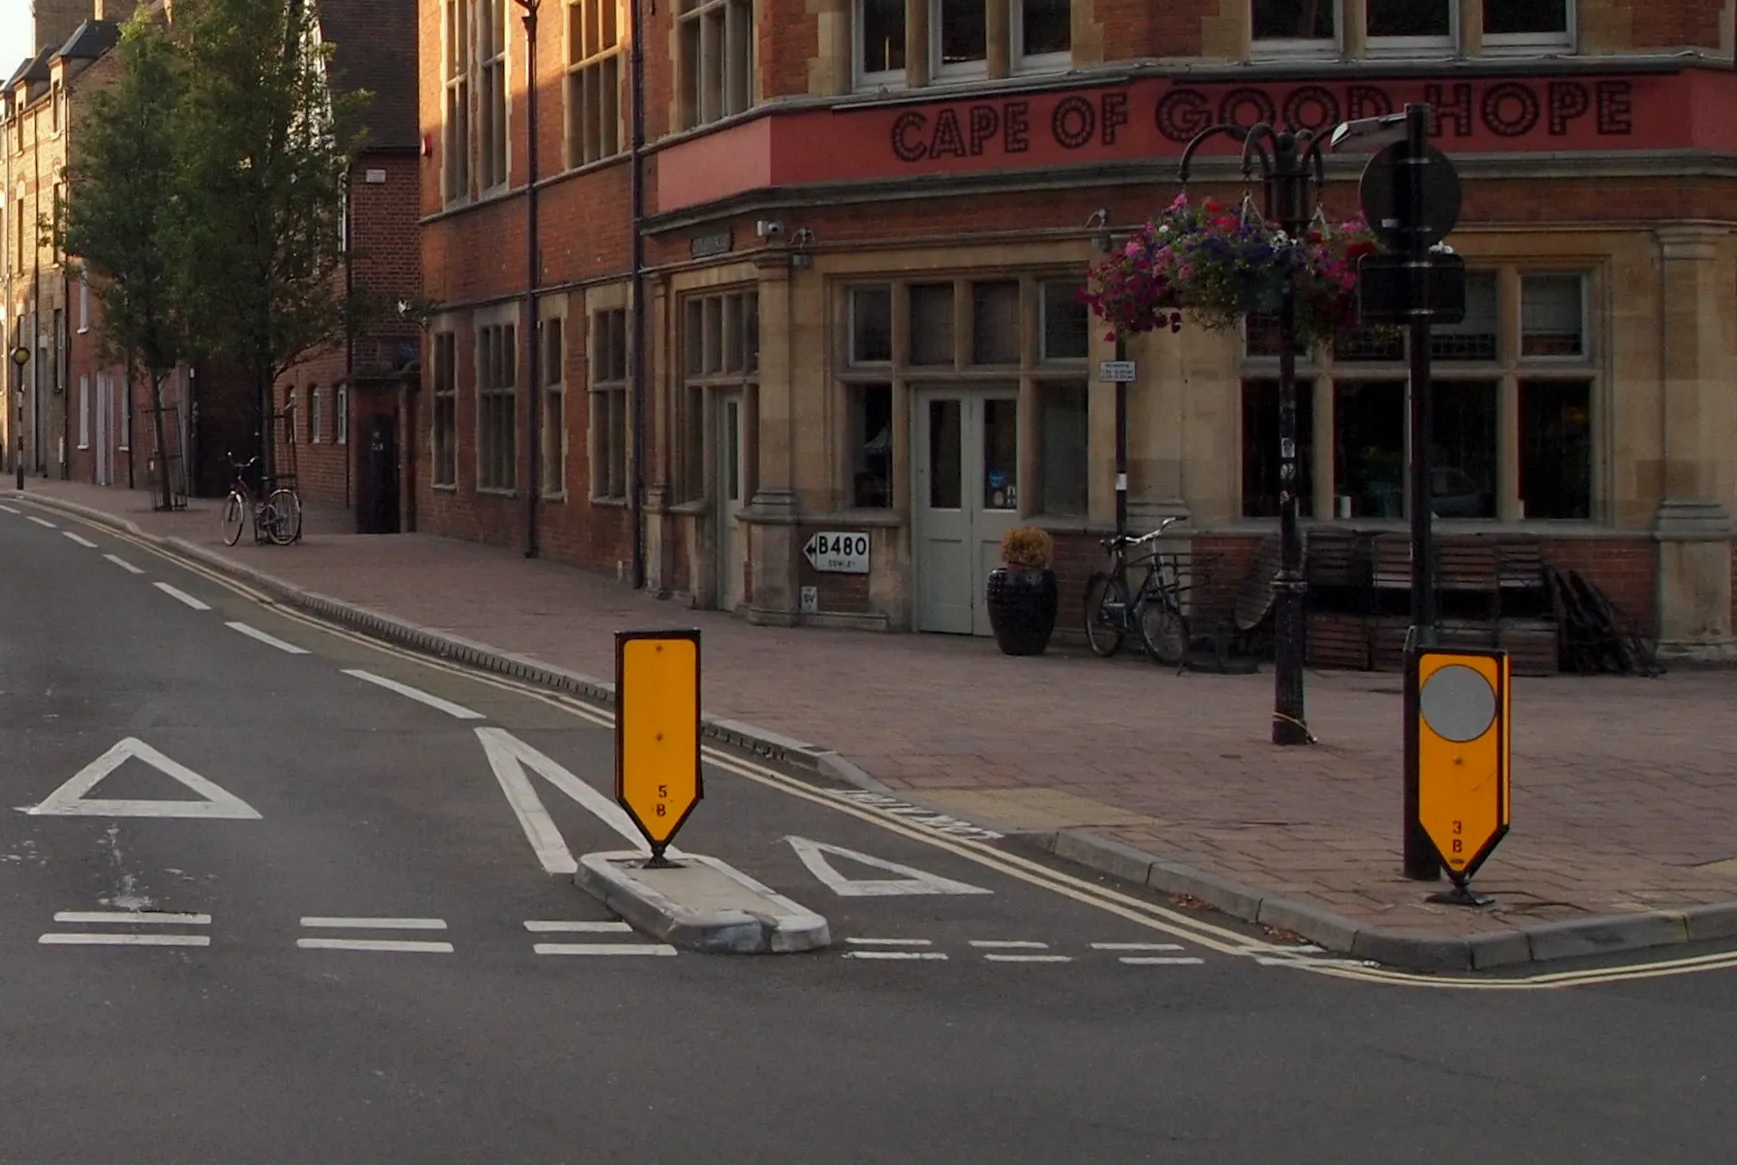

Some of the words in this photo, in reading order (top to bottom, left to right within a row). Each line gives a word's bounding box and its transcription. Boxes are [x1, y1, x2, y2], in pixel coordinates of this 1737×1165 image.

[892, 101, 1029, 162] CAPE
[1052, 93, 1128, 149] OF
[1155, 83, 1394, 143] GOOD
[1425, 81, 1632, 137] HOPE
[819, 536, 866, 555] B480
[658, 785, 667, 799] 5
[1452, 820, 1462, 835] 3
[1452, 838, 1463, 853] B
